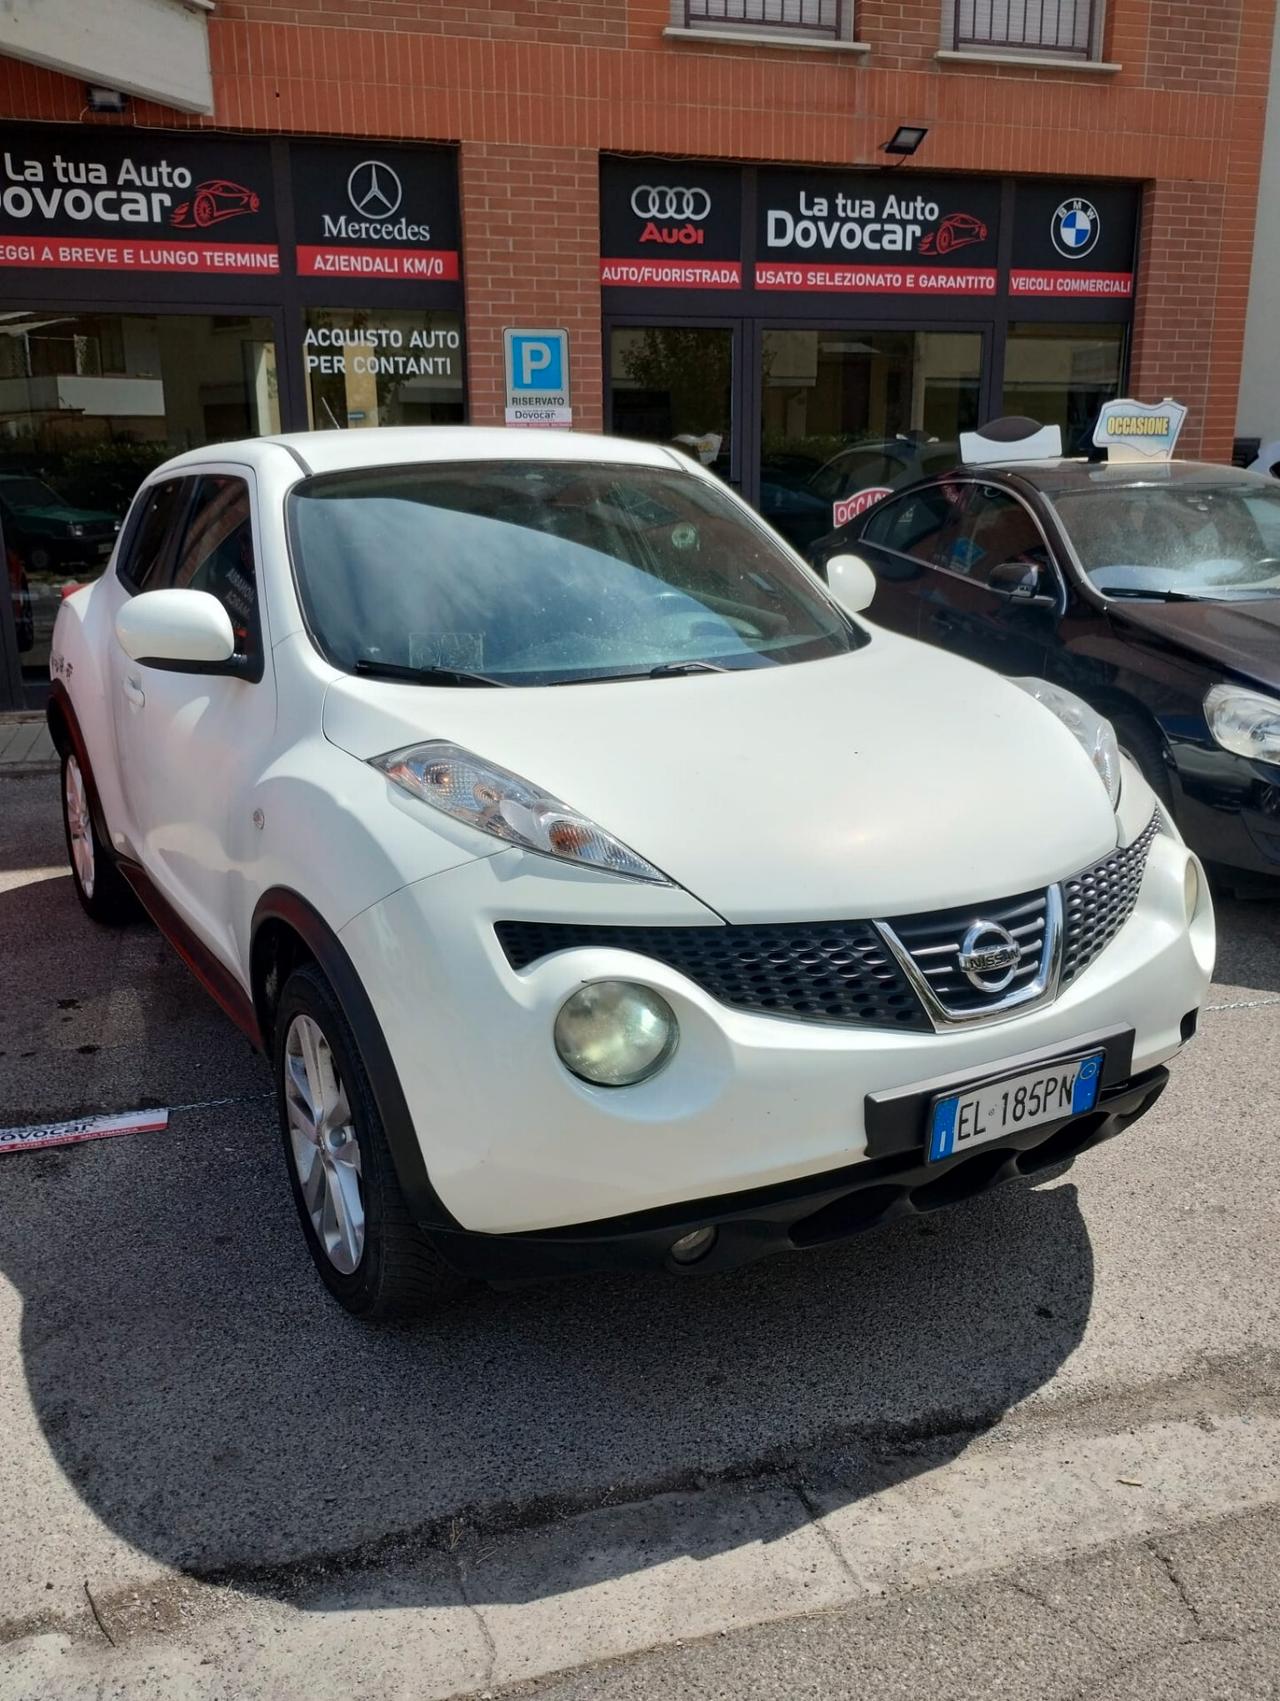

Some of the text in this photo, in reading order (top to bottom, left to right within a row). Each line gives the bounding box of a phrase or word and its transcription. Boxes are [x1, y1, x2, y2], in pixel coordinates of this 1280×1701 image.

[4, 152, 192, 189] La tua Auto
[0, 186, 172, 224] ovocar
[800, 190, 939, 221] La tua Auto
[1058, 200, 1097, 221] BMW
[322, 214, 431, 241] Mercedes
[638, 221, 705, 245] Audi
[767, 209, 921, 251] Dovocar
[41, 246, 54, 261] A
[59, 247, 118, 263] BREVE
[123, 249, 135, 263] E
[140, 249, 199, 266] LUNGO
[203, 251, 280, 269] TERMINE
[313, 254, 444, 276] AZIENDALI KM/0
[602, 266, 740, 284] AUTO/FUORISTRADA
[755, 271, 995, 289] USATO SELEZIONATO E GARANTITO
[1011, 277, 1131, 293] VEICOLI COMMERCIALI
[303, 328, 460, 350] ACQUISTO AUTO
[305, 355, 451, 375] PER CONTANTI
[521, 341, 552, 385] P
[511, 397, 565, 406] RISERVATO
[514, 410, 557, 420] Dovocar
[1107, 415, 1169, 436] OCCASIONE
[837, 493, 886, 523] OCCA
[958, 1074, 1076, 1141] EL 185PN
